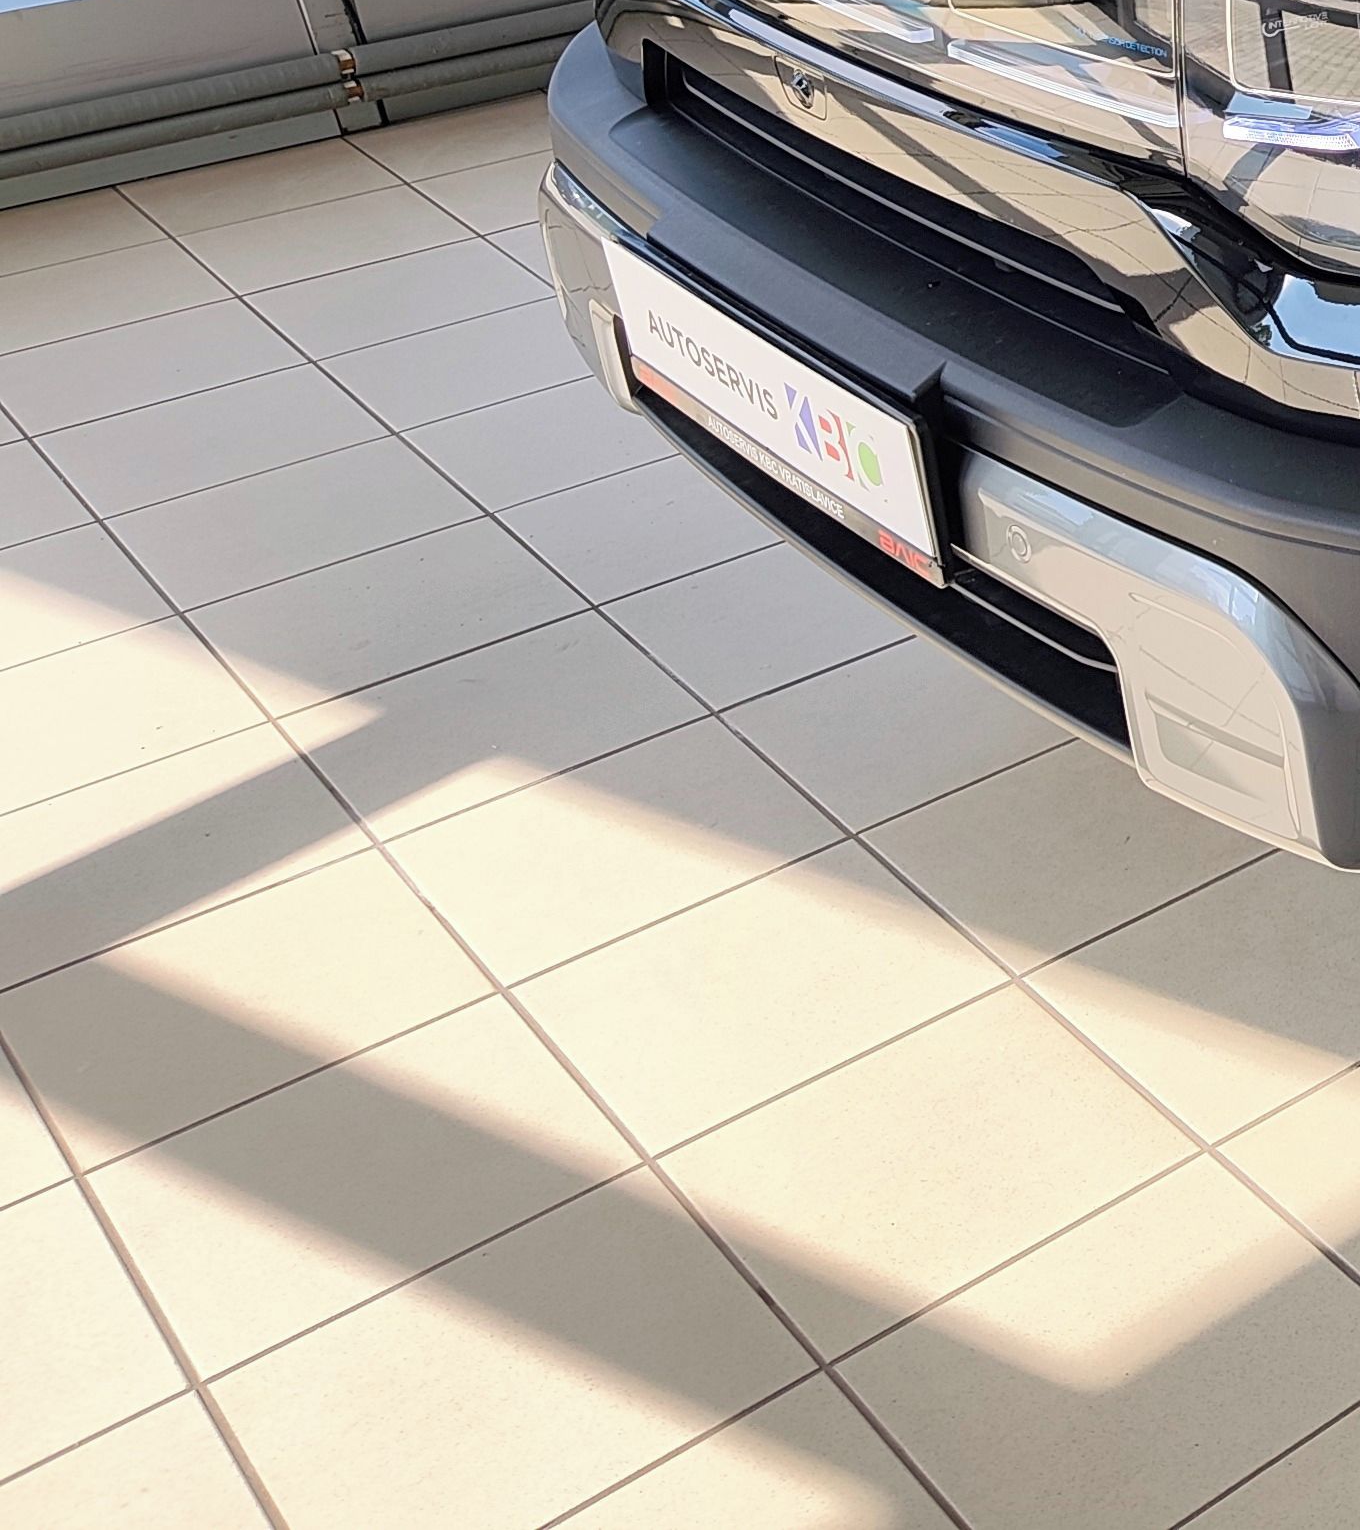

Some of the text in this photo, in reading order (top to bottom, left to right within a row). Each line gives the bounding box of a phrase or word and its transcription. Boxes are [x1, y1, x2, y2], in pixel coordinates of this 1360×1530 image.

[648, 310, 779, 421] AUTOSERVIS
[708, 415, 845, 519] AUTOSERVIS KBC VRATISLAVICE
[878, 529, 930, 578] BAIC
